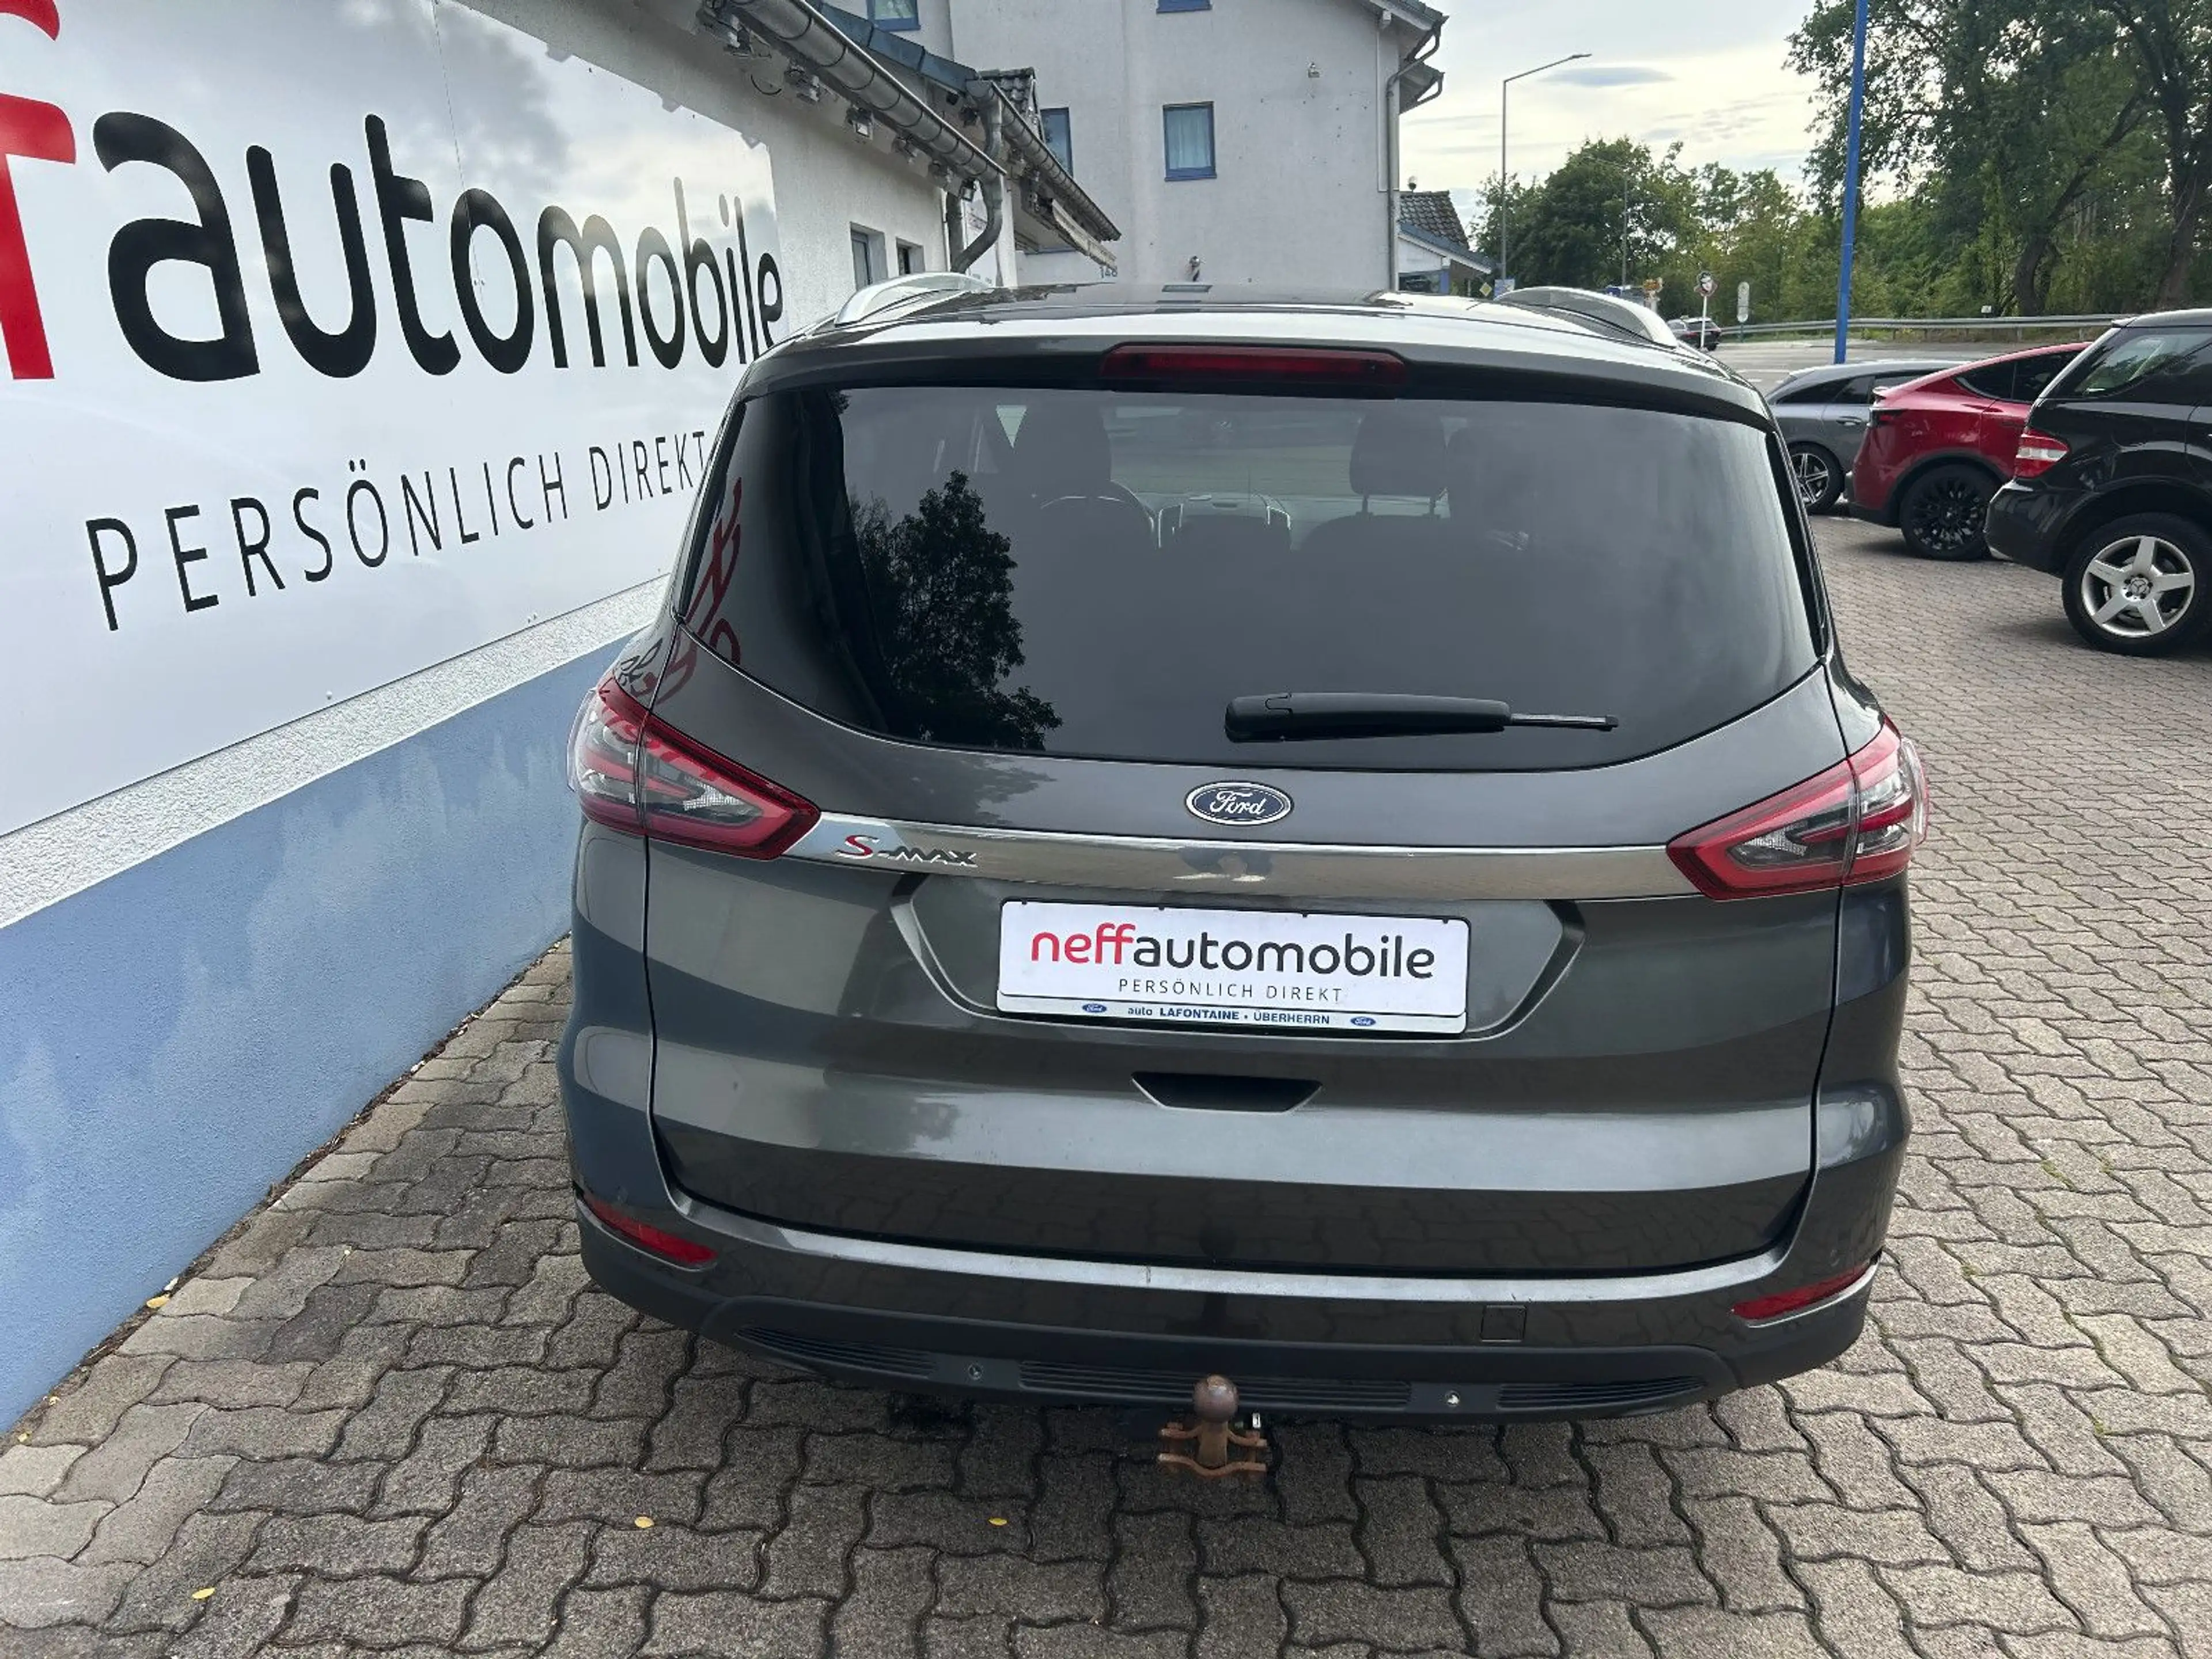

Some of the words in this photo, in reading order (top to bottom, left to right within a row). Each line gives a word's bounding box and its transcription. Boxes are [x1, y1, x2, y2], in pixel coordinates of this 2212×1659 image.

[86, 452, 568, 631] PERSÖNLICH
[589, 431, 704, 511] DIREKT
[1209, 790, 1267, 815] Ford
[835, 835, 978, 868] S-MAX
[1031, 922, 1434, 979] neffautomobile
[1119, 978, 1253, 998] PERSÖNLICH
[1267, 985, 1342, 1002] DIREKT
[1127, 1007, 1153, 1016] auto
[1160, 1008, 1239, 1020] LAFONTAINE
[1254, 1010, 1330, 1024] ÜBERHERRN
